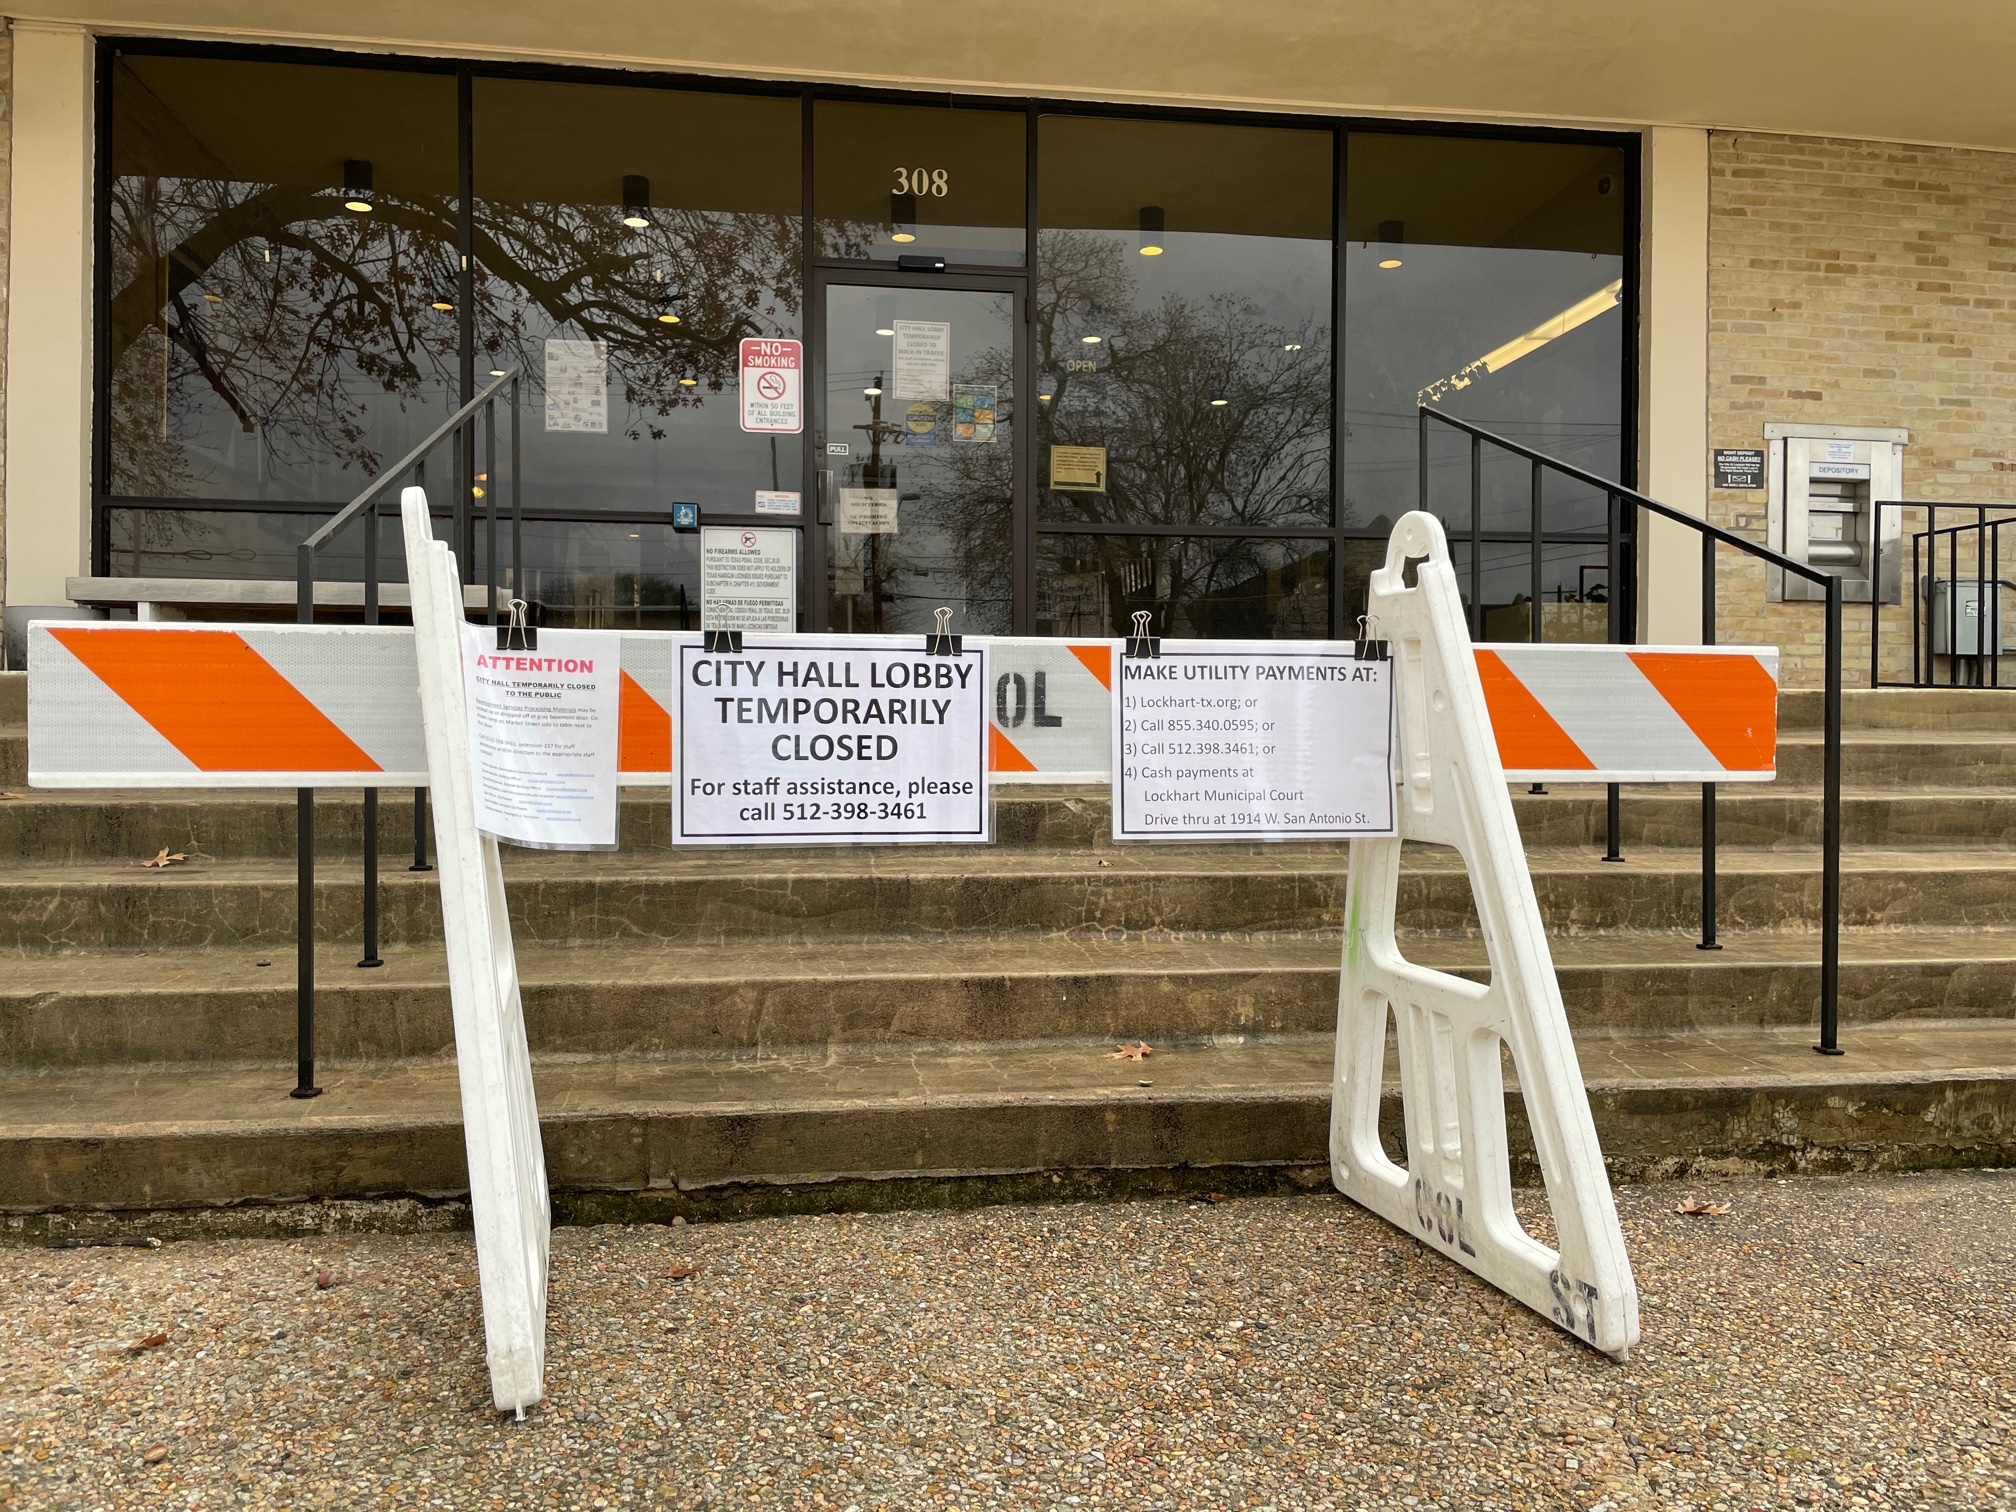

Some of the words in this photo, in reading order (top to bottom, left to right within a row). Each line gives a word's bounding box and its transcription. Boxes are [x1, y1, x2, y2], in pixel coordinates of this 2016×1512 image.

[892, 167, 948, 197] 308
[761, 342, 782, 355] NO
[748, 356, 795, 367] SMOKING
[1067, 360, 1097, 372] OPEN
[477, 654, 593, 673] ATTENTION
[476, 676, 489, 684] CITY
[692, 660, 766, 687] CITY
[777, 661, 859, 687] HALL
[871, 662, 973, 689] LOBBY
[1124, 665, 1178, 680] MAKE
[1184, 665, 1250, 680] UTILITY
[1256, 666, 1347, 681] PAYMENTS
[1351, 667, 1377, 682] AT:
[1124, 696, 1137, 710] 1)
[1141, 696, 1241, 710] Lockhart-tx.org;
[1245, 699, 1258, 708] or
[714, 697, 952, 724] TEMPORARILY
[1124, 720, 1137, 733] 2)
[1141, 719, 1164, 731] Call
[1168, 720, 1258, 733] 855.340.0595;
[1262, 722, 1275, 731] or
[771, 734, 898, 761] CLOSED
[1124, 743, 1137, 757] 3)
[1141, 743, 1164, 755] Call
[1168, 743, 1259, 756] 512.398.3461;
[1262, 745, 1276, 754] or
[1124, 766, 1138, 781] 4)
[1141, 766, 1172, 778] Cash
[1176, 767, 1239, 780] payments
[1242, 767, 1254, 778] at
[691, 778, 725, 795] For
[732, 777, 781, 795] staff
[786, 777, 901, 798] assistance,
[908, 776, 973, 799] please
[1145, 790, 1200, 802] Lockhart
[1204, 789, 1266, 803] Municipal
[1269, 789, 1304, 801] Court
[740, 802, 775, 821] call
[783, 802, 927, 820] 512-398-3461
[1145, 814, 1179, 825] Drive
[1183, 813, 1210, 825] thru
[1214, 815, 1226, 825] at
[1230, 813, 1261, 825] 1914
[1264, 813, 1280, 824] W.
[1284, 813, 1305, 824] San
[1309, 813, 1352, 824] Antonio
[1355, 812, 1370, 824] St.
